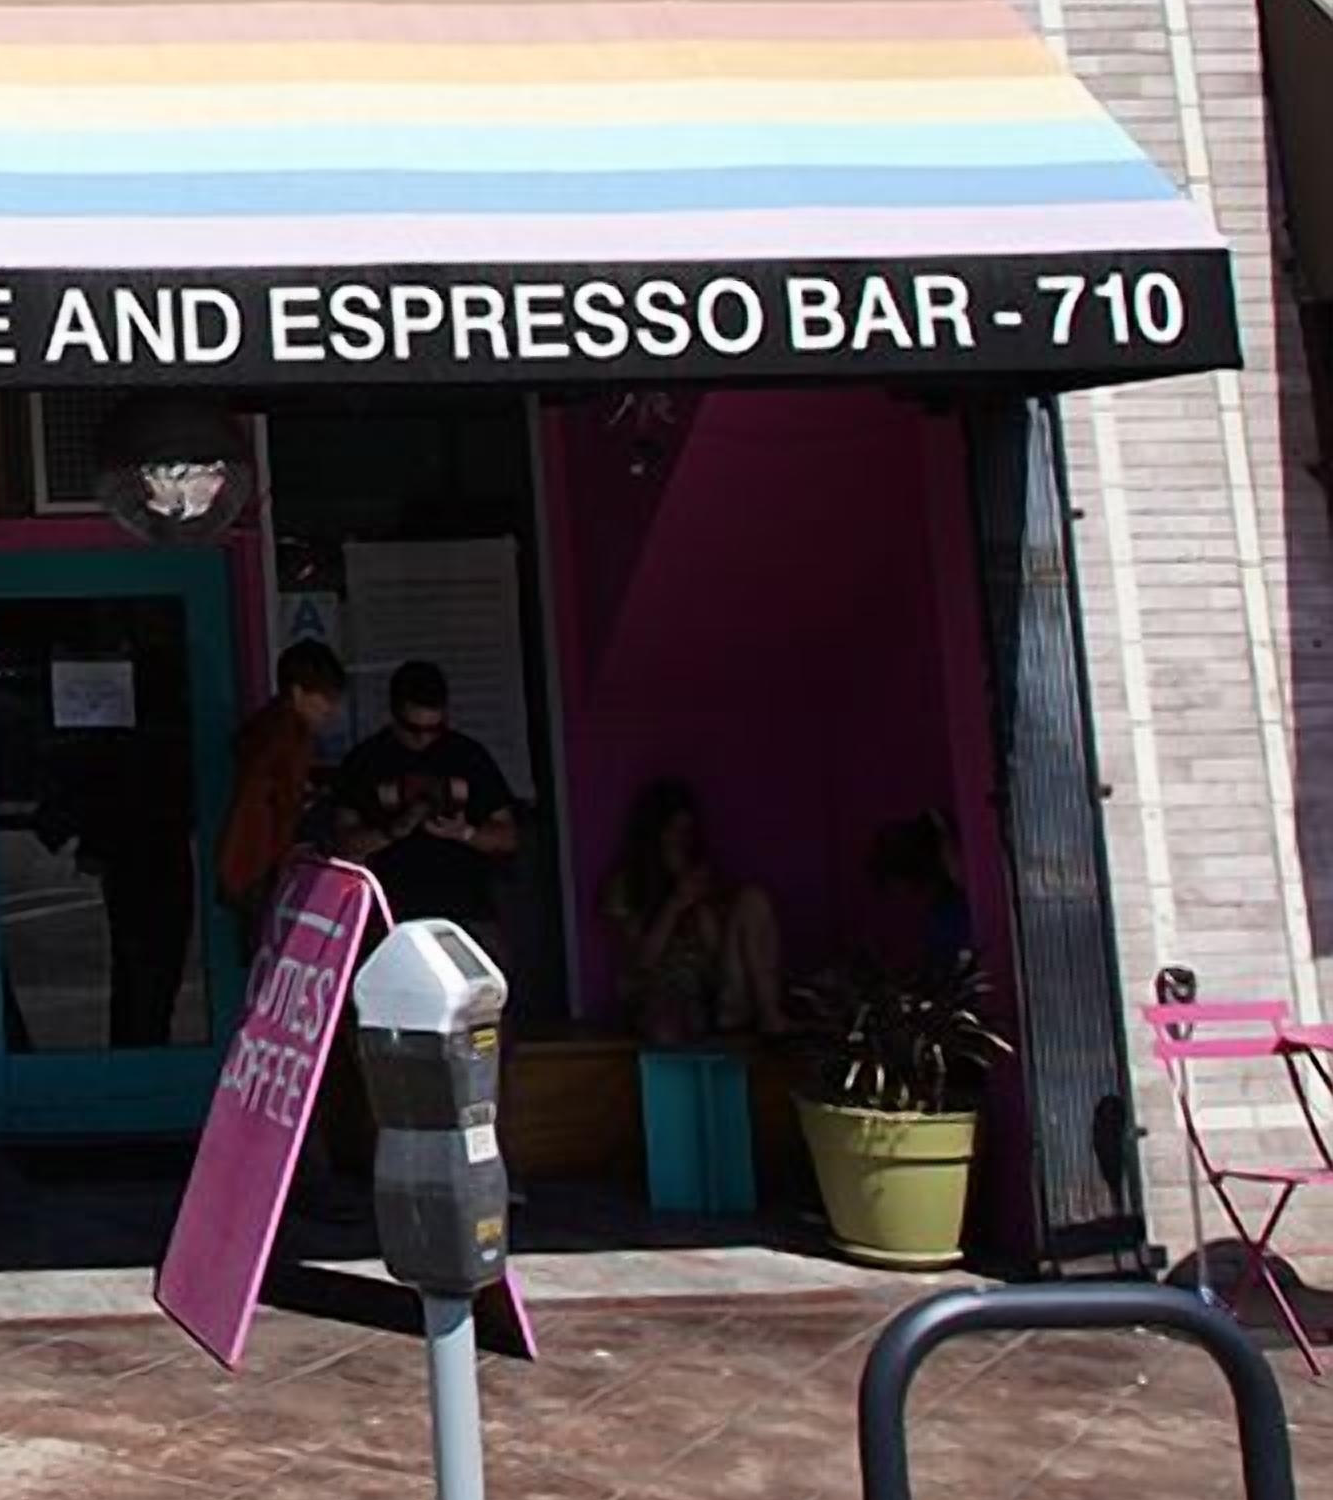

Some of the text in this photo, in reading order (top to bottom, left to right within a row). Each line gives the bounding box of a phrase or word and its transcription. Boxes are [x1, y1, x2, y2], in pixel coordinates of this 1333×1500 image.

[44, 286, 242, 364] AND
[269, 276, 764, 363] ESPRESSO
[786, 275, 974, 351] BAR
[1037, 272, 1185, 344] 710
[291, 600, 326, 637] A
